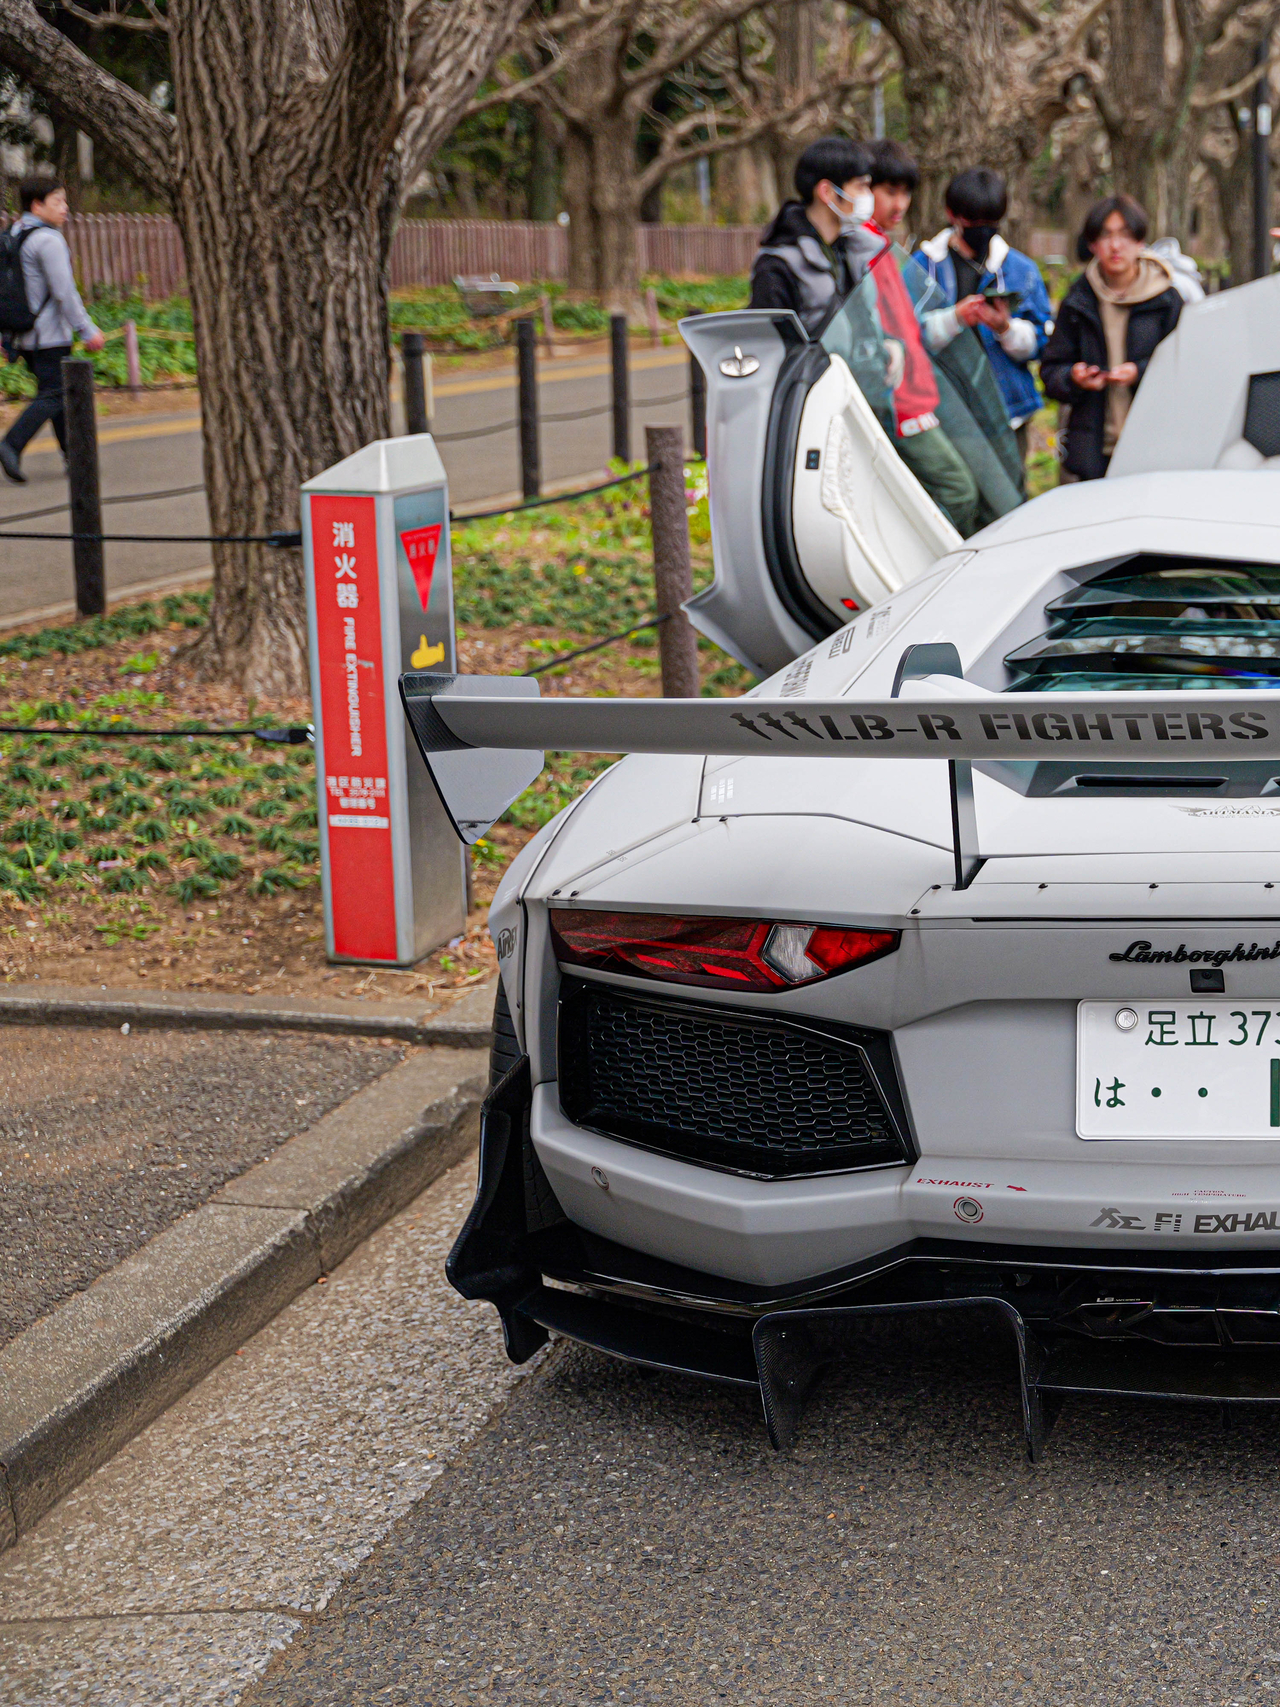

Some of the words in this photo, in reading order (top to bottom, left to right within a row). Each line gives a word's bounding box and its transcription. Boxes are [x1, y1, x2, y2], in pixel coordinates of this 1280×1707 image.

[332, 521, 360, 608] 消火器
[343, 616, 357, 651] FIRE
[820, 712, 963, 741] LB-R
[977, 711, 1270, 742] FIGHTERS
[916, 1178, 995, 1190] EXHAUST
